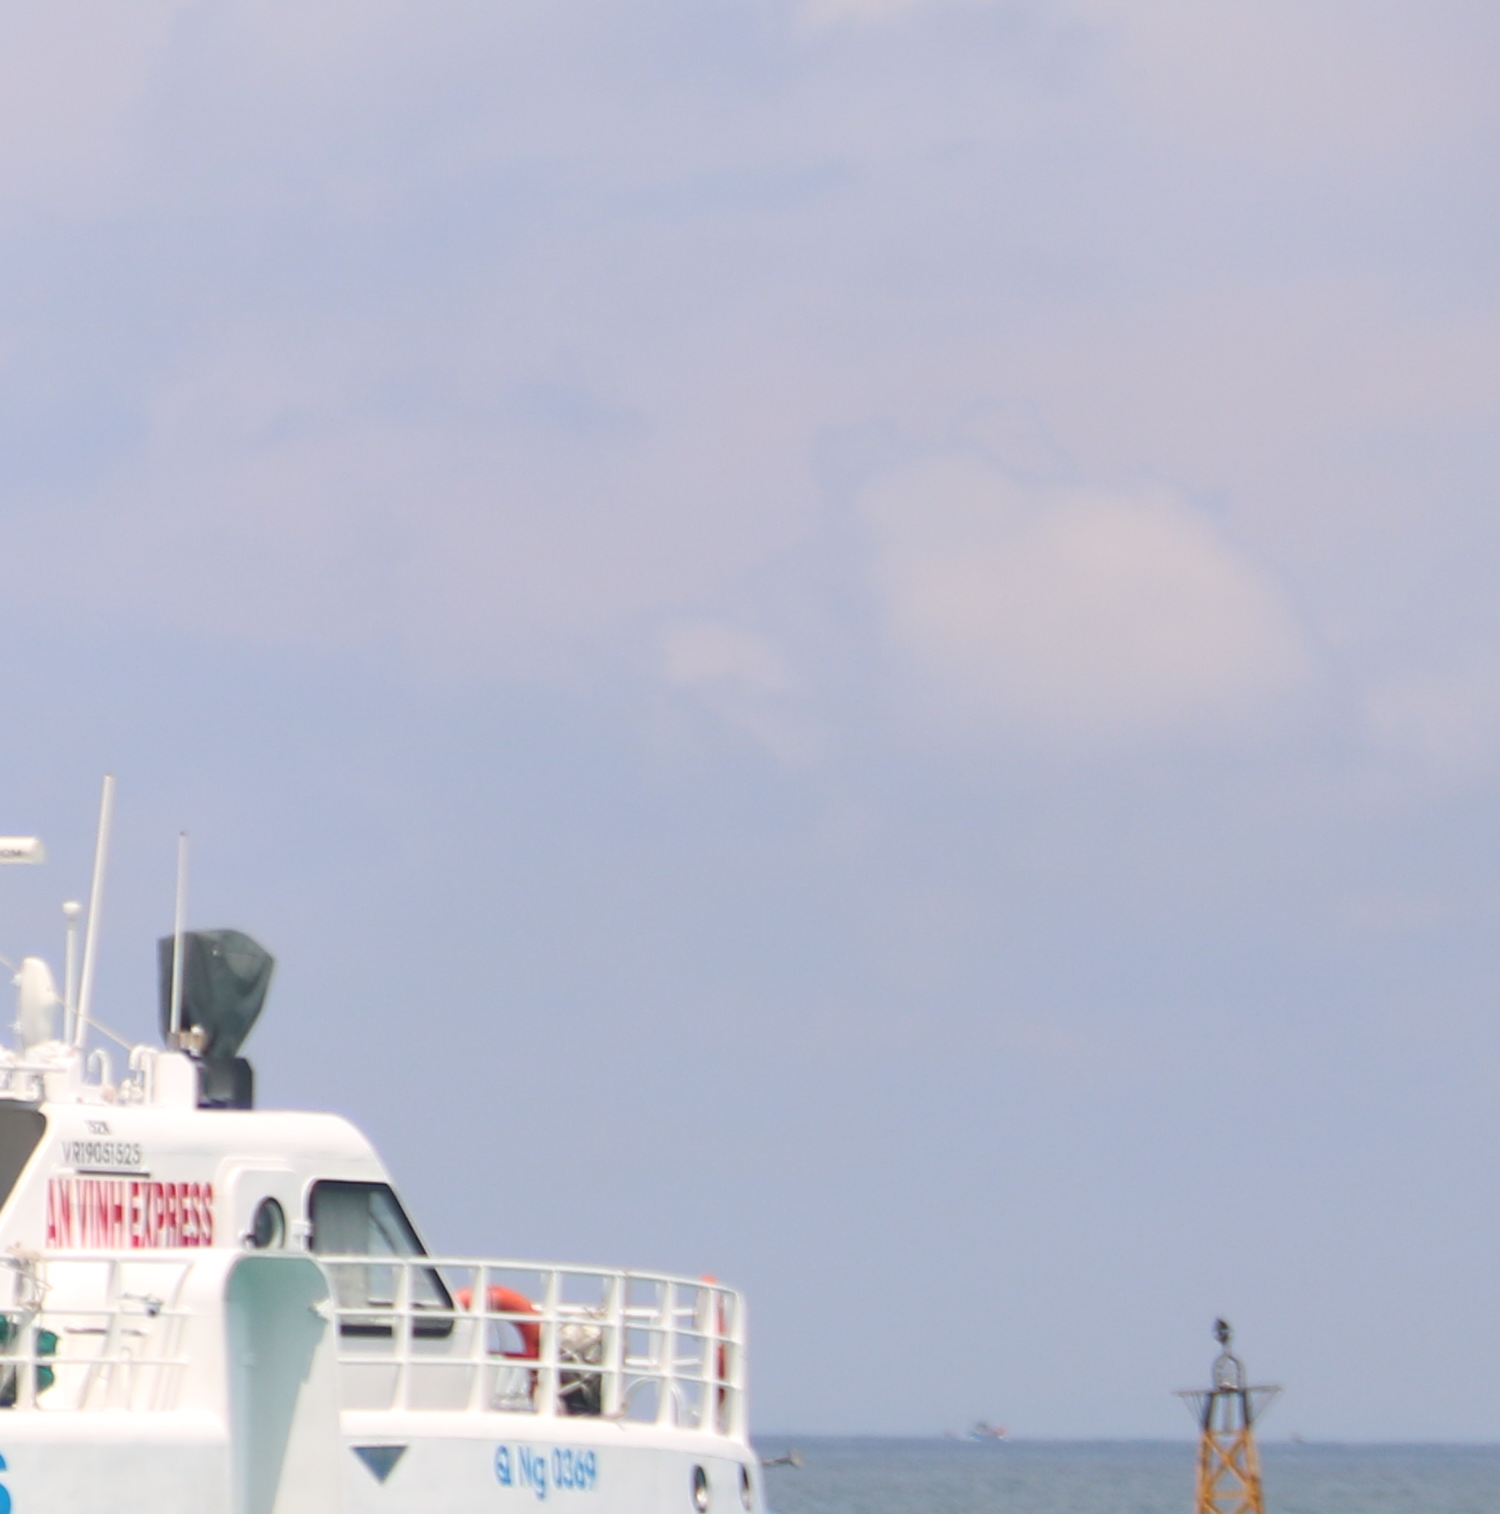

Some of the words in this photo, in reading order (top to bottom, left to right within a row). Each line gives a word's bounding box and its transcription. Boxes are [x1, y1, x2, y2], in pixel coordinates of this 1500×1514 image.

[46, 1179, 71, 1248] AN
[128, 1181, 213, 1248] EXPRESS
[517, 1445, 546, 1500] Ng
[552, 1447, 597, 1490] 0369
